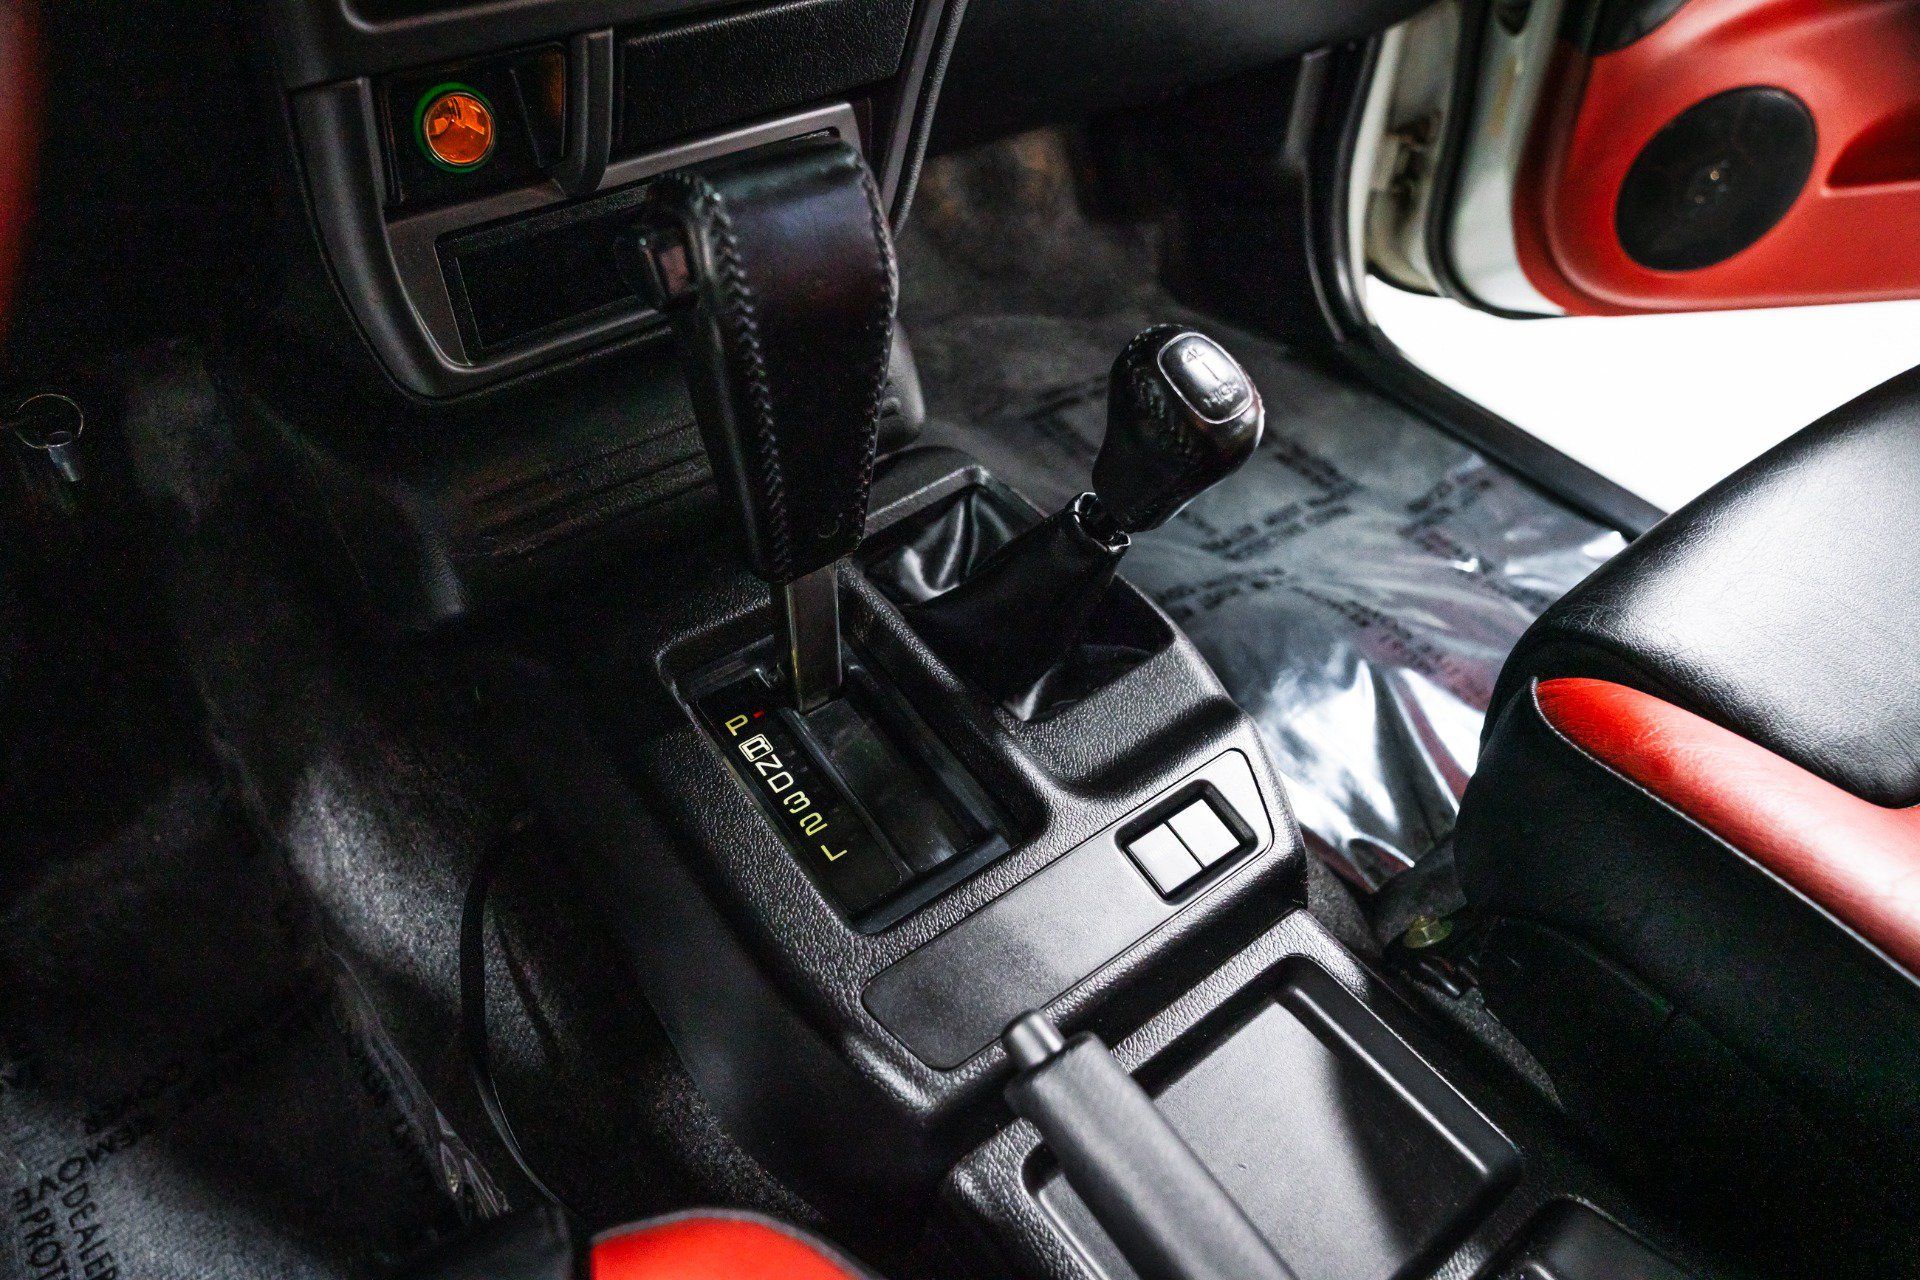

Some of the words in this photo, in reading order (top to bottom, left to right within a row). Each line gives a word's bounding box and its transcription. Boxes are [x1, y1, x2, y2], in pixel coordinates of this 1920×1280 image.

[725, 714, 749, 737] P
[743, 735, 772, 761] R
[755, 754, 783, 777] N
[767, 771, 794, 794] D
[783, 791, 811, 814] 3
[800, 812, 828, 837] 2
[820, 844, 848, 862] L
